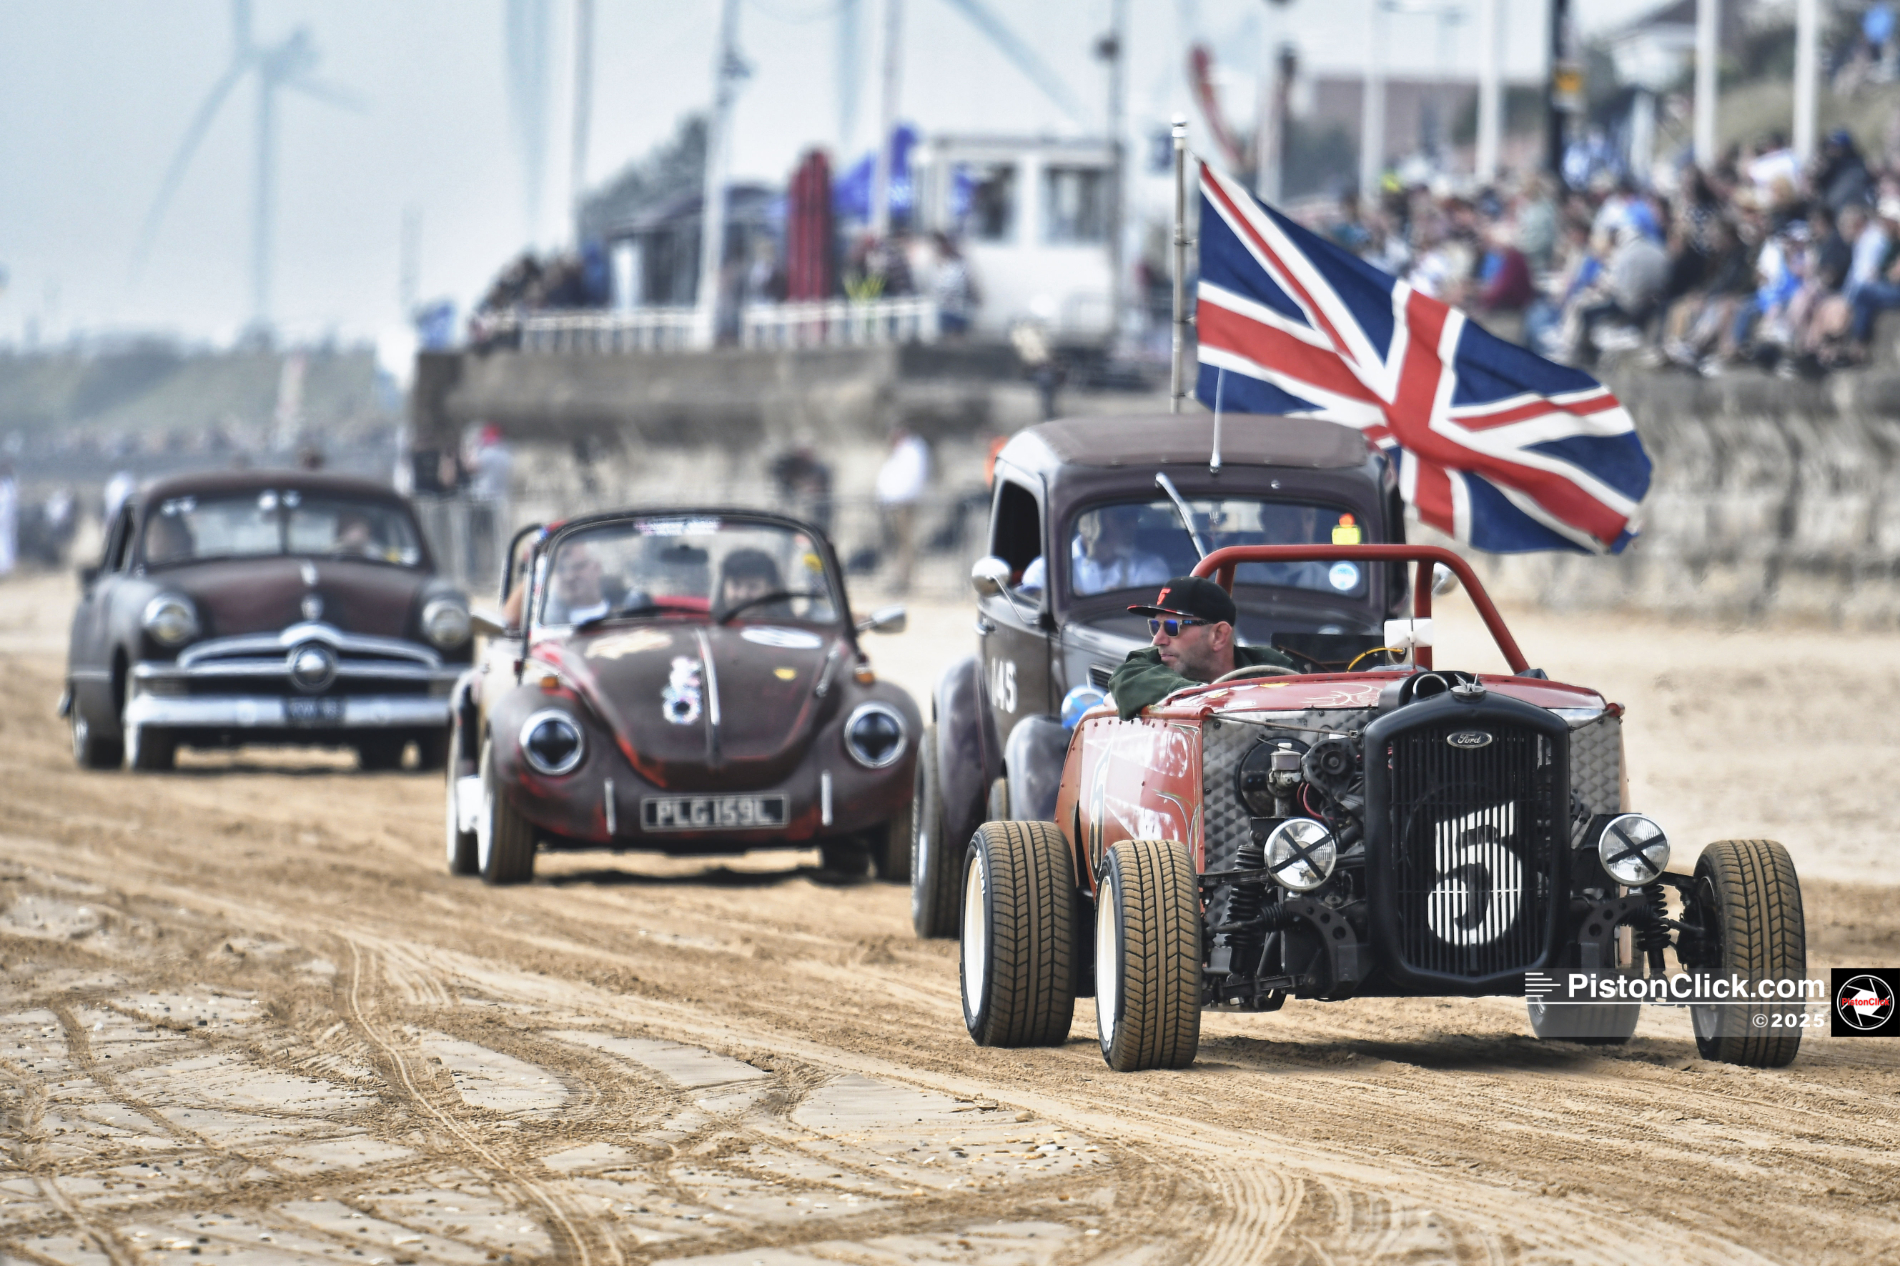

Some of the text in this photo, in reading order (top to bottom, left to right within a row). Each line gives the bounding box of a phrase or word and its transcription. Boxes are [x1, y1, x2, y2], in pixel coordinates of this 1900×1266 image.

[1457, 733, 1481, 744] Ford
[657, 798, 774, 827] PLG 159L
[1428, 801, 1522, 947] 5
